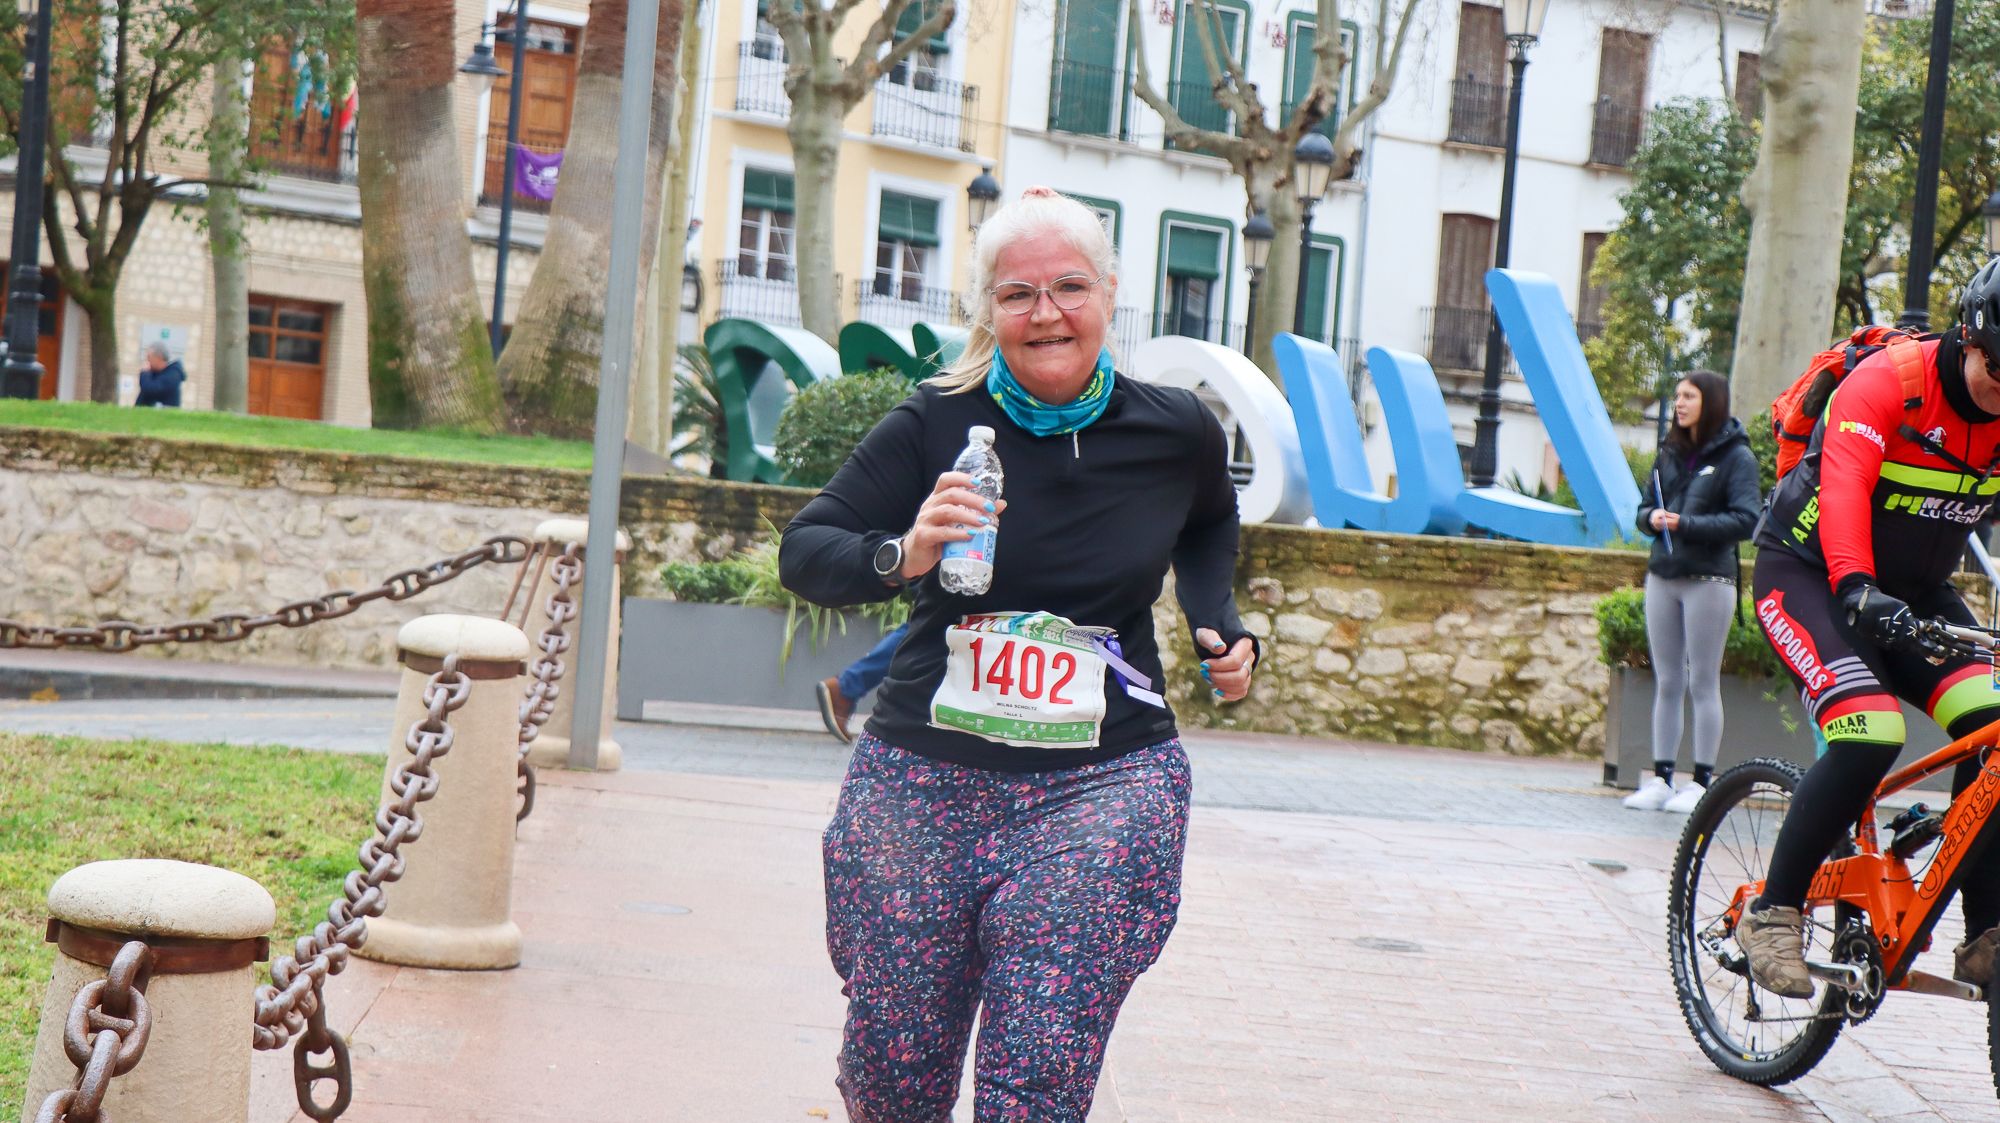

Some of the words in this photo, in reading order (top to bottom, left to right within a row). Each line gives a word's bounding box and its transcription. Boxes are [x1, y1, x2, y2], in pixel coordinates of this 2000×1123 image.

[1798, 488, 1820, 531] RE
[969, 637, 1077, 705] 1402
[1760, 599, 1828, 691] CAMPOARAS
[1827, 714, 1867, 731] MILAR
[1828, 727, 1868, 738] LUCENA
[1919, 765, 1999, 900] Orange
